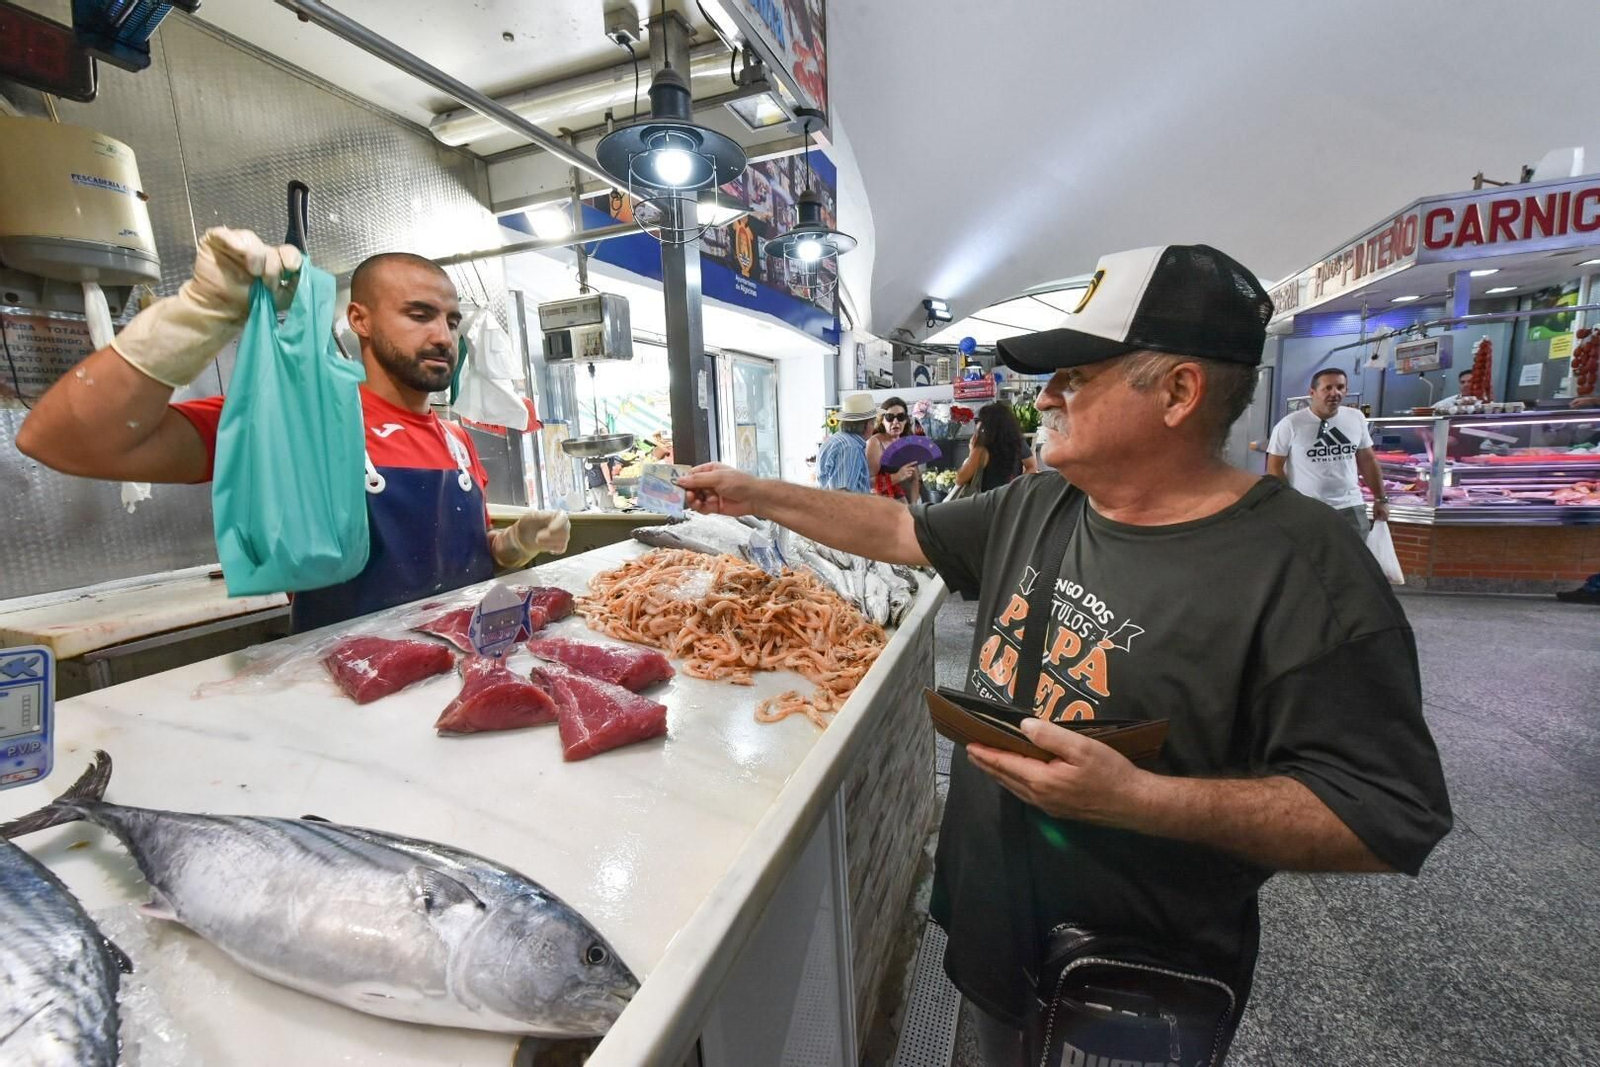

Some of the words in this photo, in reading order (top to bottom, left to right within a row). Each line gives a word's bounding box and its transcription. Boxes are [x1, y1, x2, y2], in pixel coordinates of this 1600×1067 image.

[1306, 444, 1357, 458] adidas
[1311, 455, 1353, 463] ATHLETICS
[1051, 599, 1093, 638] TULOS
[1082, 593, 1115, 624] DOS
